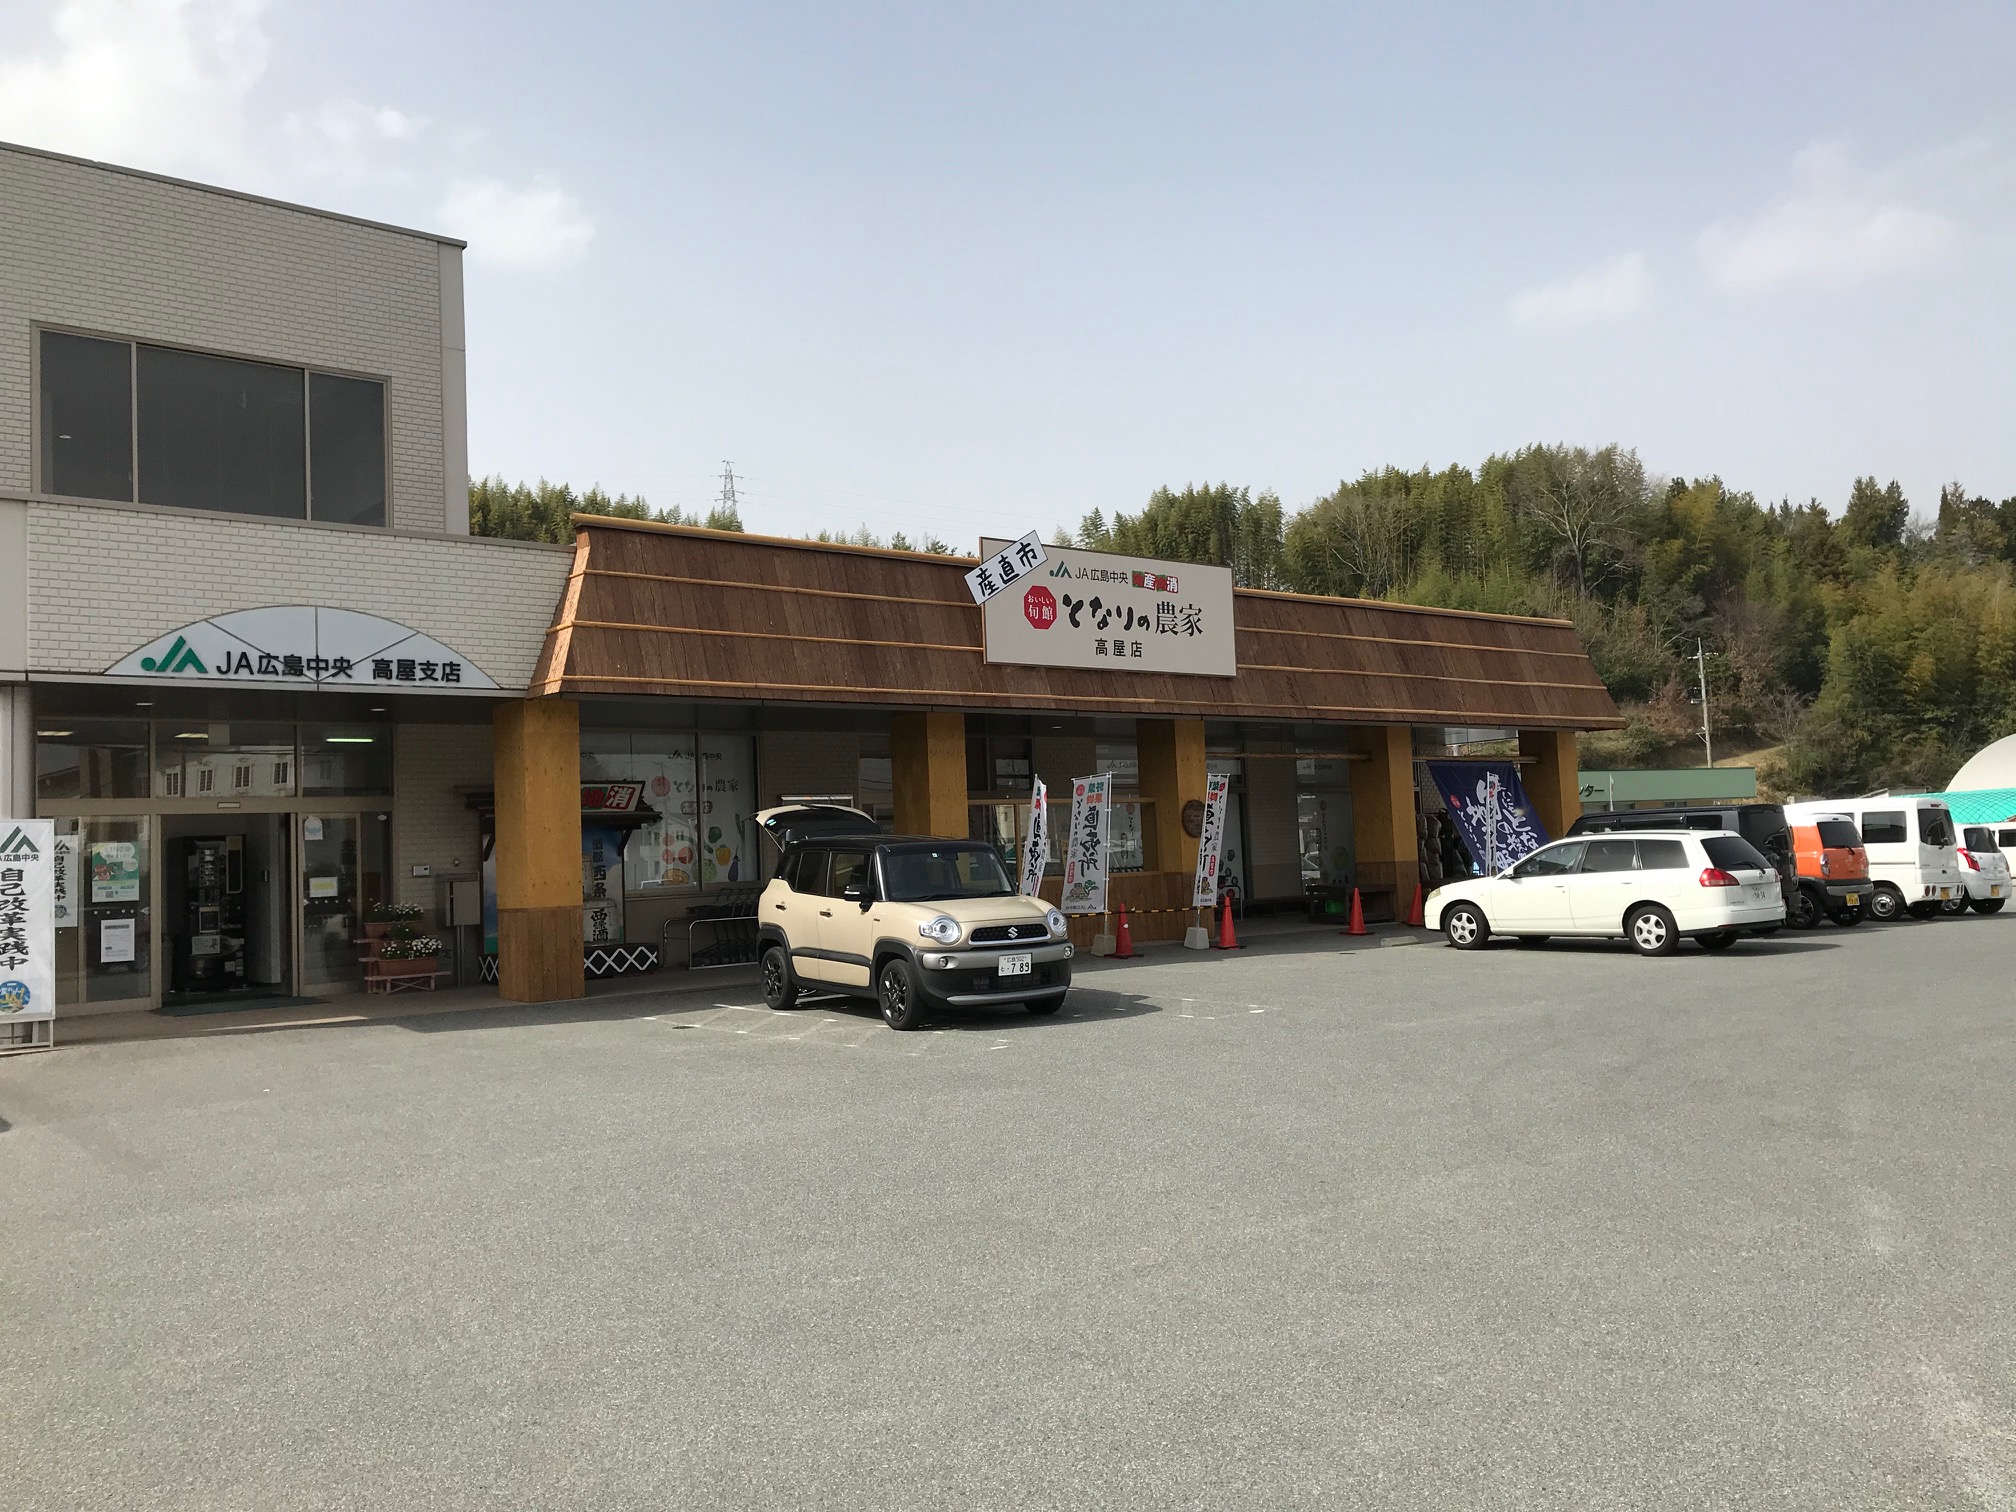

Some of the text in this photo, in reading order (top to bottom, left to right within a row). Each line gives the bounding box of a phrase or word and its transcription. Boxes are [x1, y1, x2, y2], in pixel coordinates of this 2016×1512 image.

[975, 540, 1038, 598] 産直市
[1075, 567, 1129, 585] JA広島中央
[1027, 594, 1053, 604] おいしい
[1027, 604, 1053, 621] 旬館
[1062, 593, 1203, 637] となりの農家
[1094, 638, 1143, 658] 高屋店
[216, 650, 353, 680] JA広島中央
[371, 658, 461, 683] 高屋支店
[0, 867, 30, 971] 自己改革実践中
